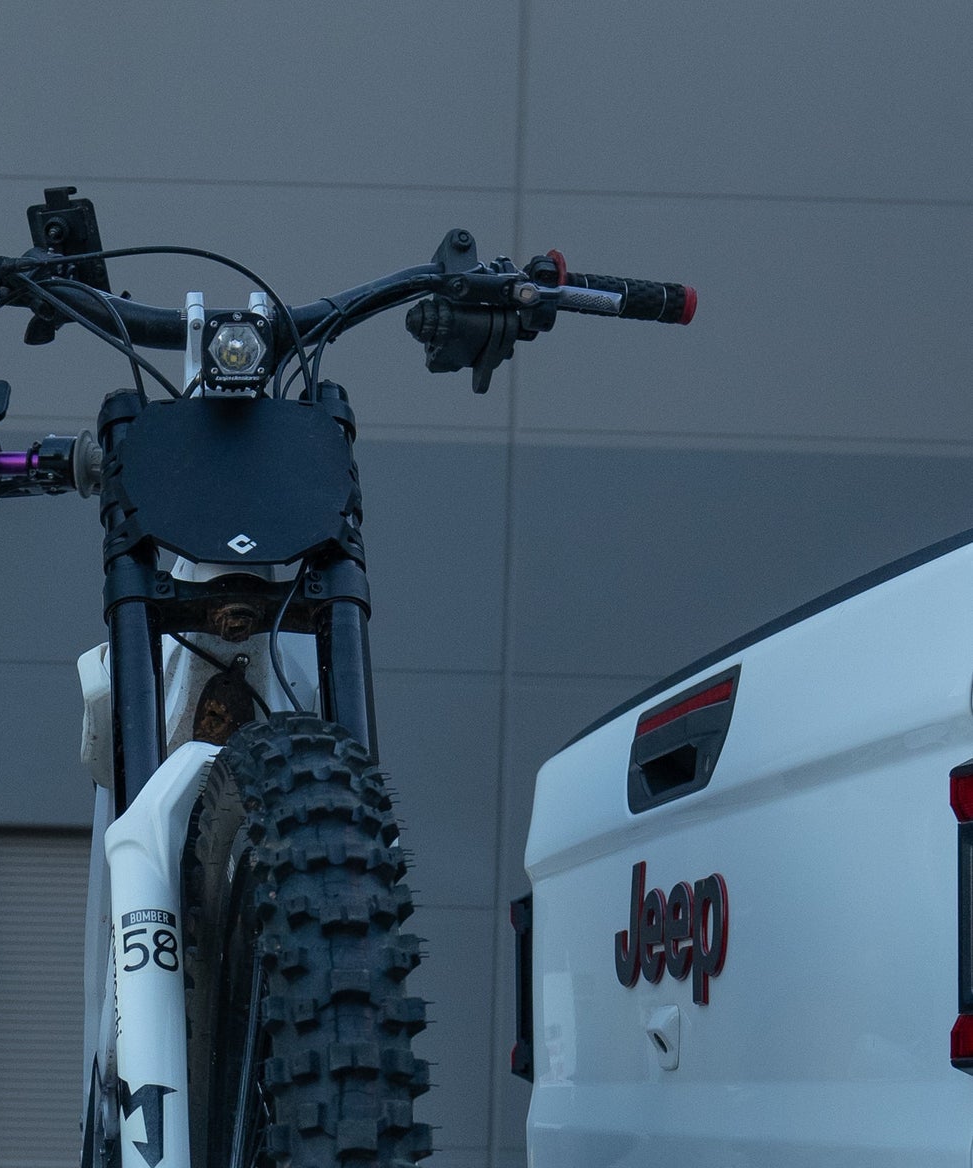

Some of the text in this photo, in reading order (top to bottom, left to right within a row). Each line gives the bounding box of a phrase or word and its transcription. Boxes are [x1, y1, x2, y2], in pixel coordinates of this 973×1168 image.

[129, 910, 170, 924] BOMBER
[614, 860, 729, 1006] Jeep
[123, 927, 180, 973] 58
